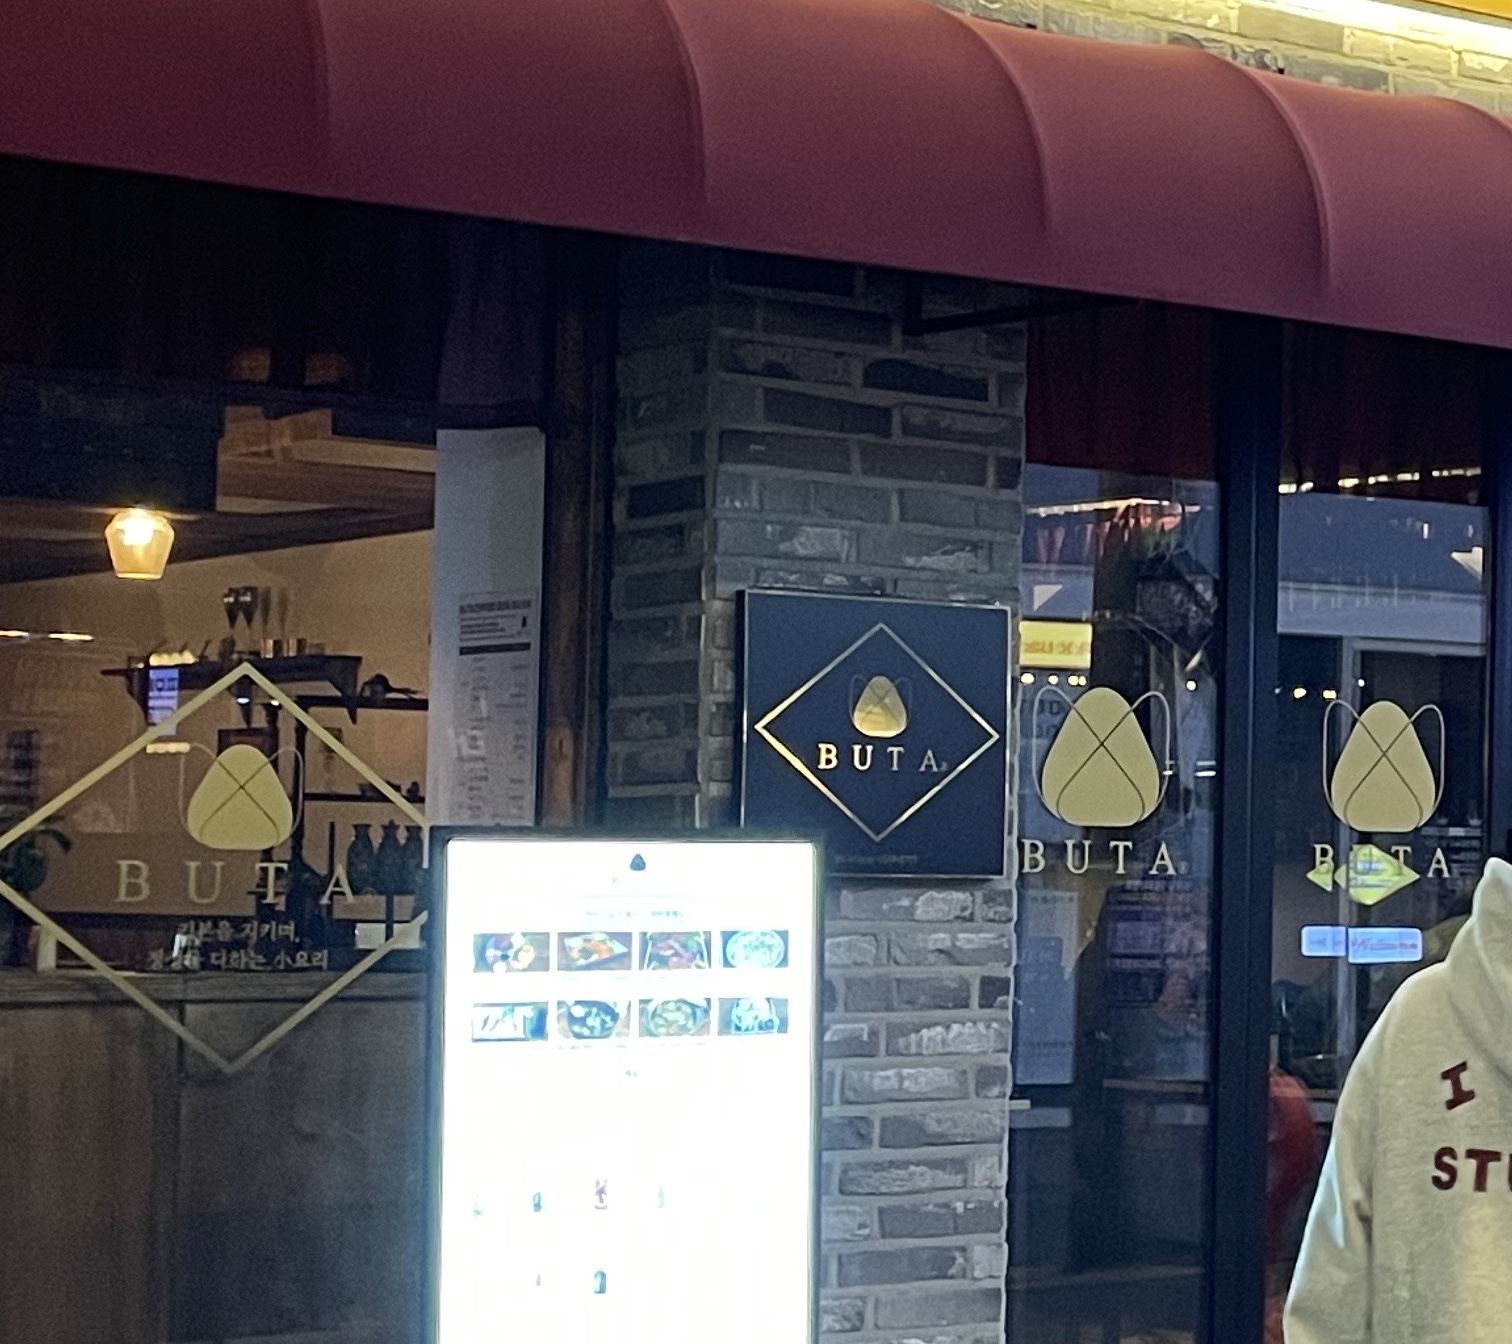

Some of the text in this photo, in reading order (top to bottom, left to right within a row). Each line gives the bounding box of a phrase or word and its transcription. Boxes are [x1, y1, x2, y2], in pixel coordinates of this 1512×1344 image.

[817, 742, 939, 773] BUTA
[1020, 838, 1178, 876] BUTA
[114, 859, 356, 905] BUTA
